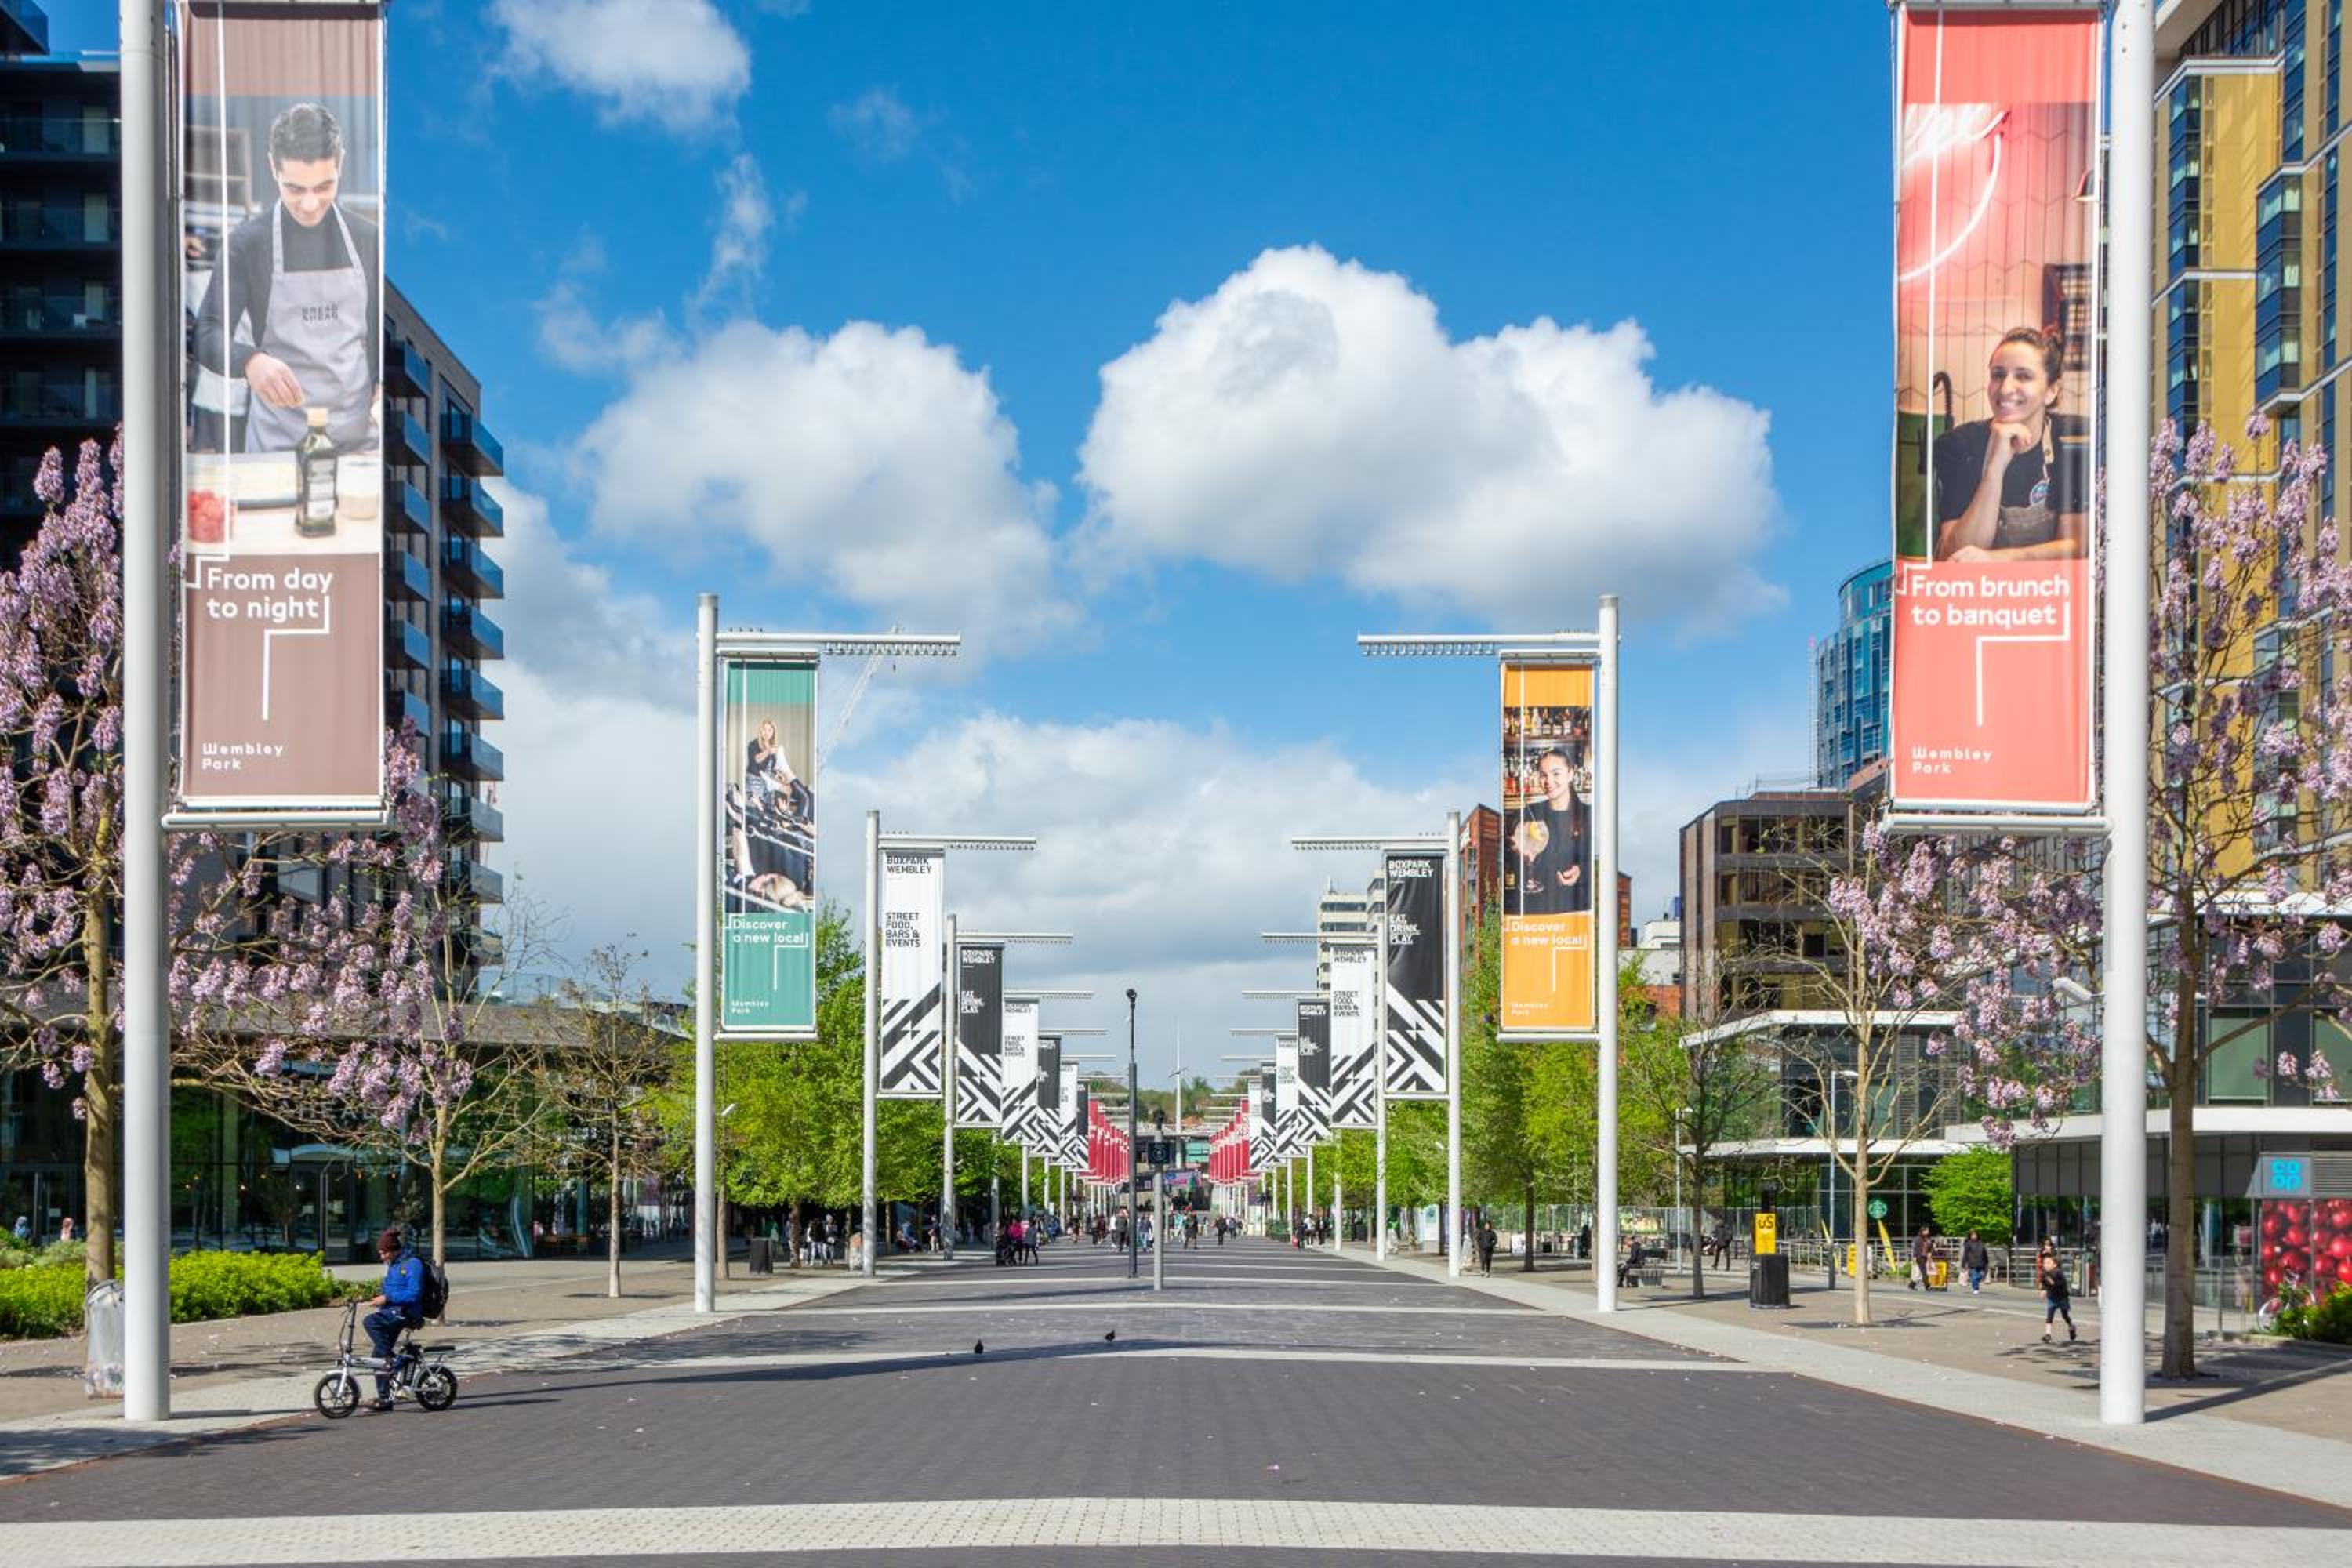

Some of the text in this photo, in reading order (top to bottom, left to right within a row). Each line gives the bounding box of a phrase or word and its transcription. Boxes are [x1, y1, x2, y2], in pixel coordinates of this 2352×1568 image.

[207, 568, 333, 593] From day
[1911, 575, 2070, 597] From brunch
[207, 597, 318, 623] to night
[1911, 604, 2056, 630] to banquet
[202, 743, 283, 757] Wembley
[1912, 746, 1992, 761] Wembley
[202, 758, 242, 770] Park
[1912, 762, 1951, 774] Park
[887, 855, 929, 864] BOXPARK
[1388, 860, 1430, 869] BOXPARK
[887, 866, 931, 874] WEMBLEY
[1388, 869, 1434, 877] WEMBLEY
[885, 912, 920, 920] STREET
[732, 919, 789, 930] Discover
[886, 920, 913, 930] FOOD,
[1511, 921, 1566, 932] Discover
[733, 932, 804, 943] a new local
[885, 929, 920, 938] BARS &
[886, 939, 921, 948] EVENTS
[1511, 934, 1581, 946] a new local
